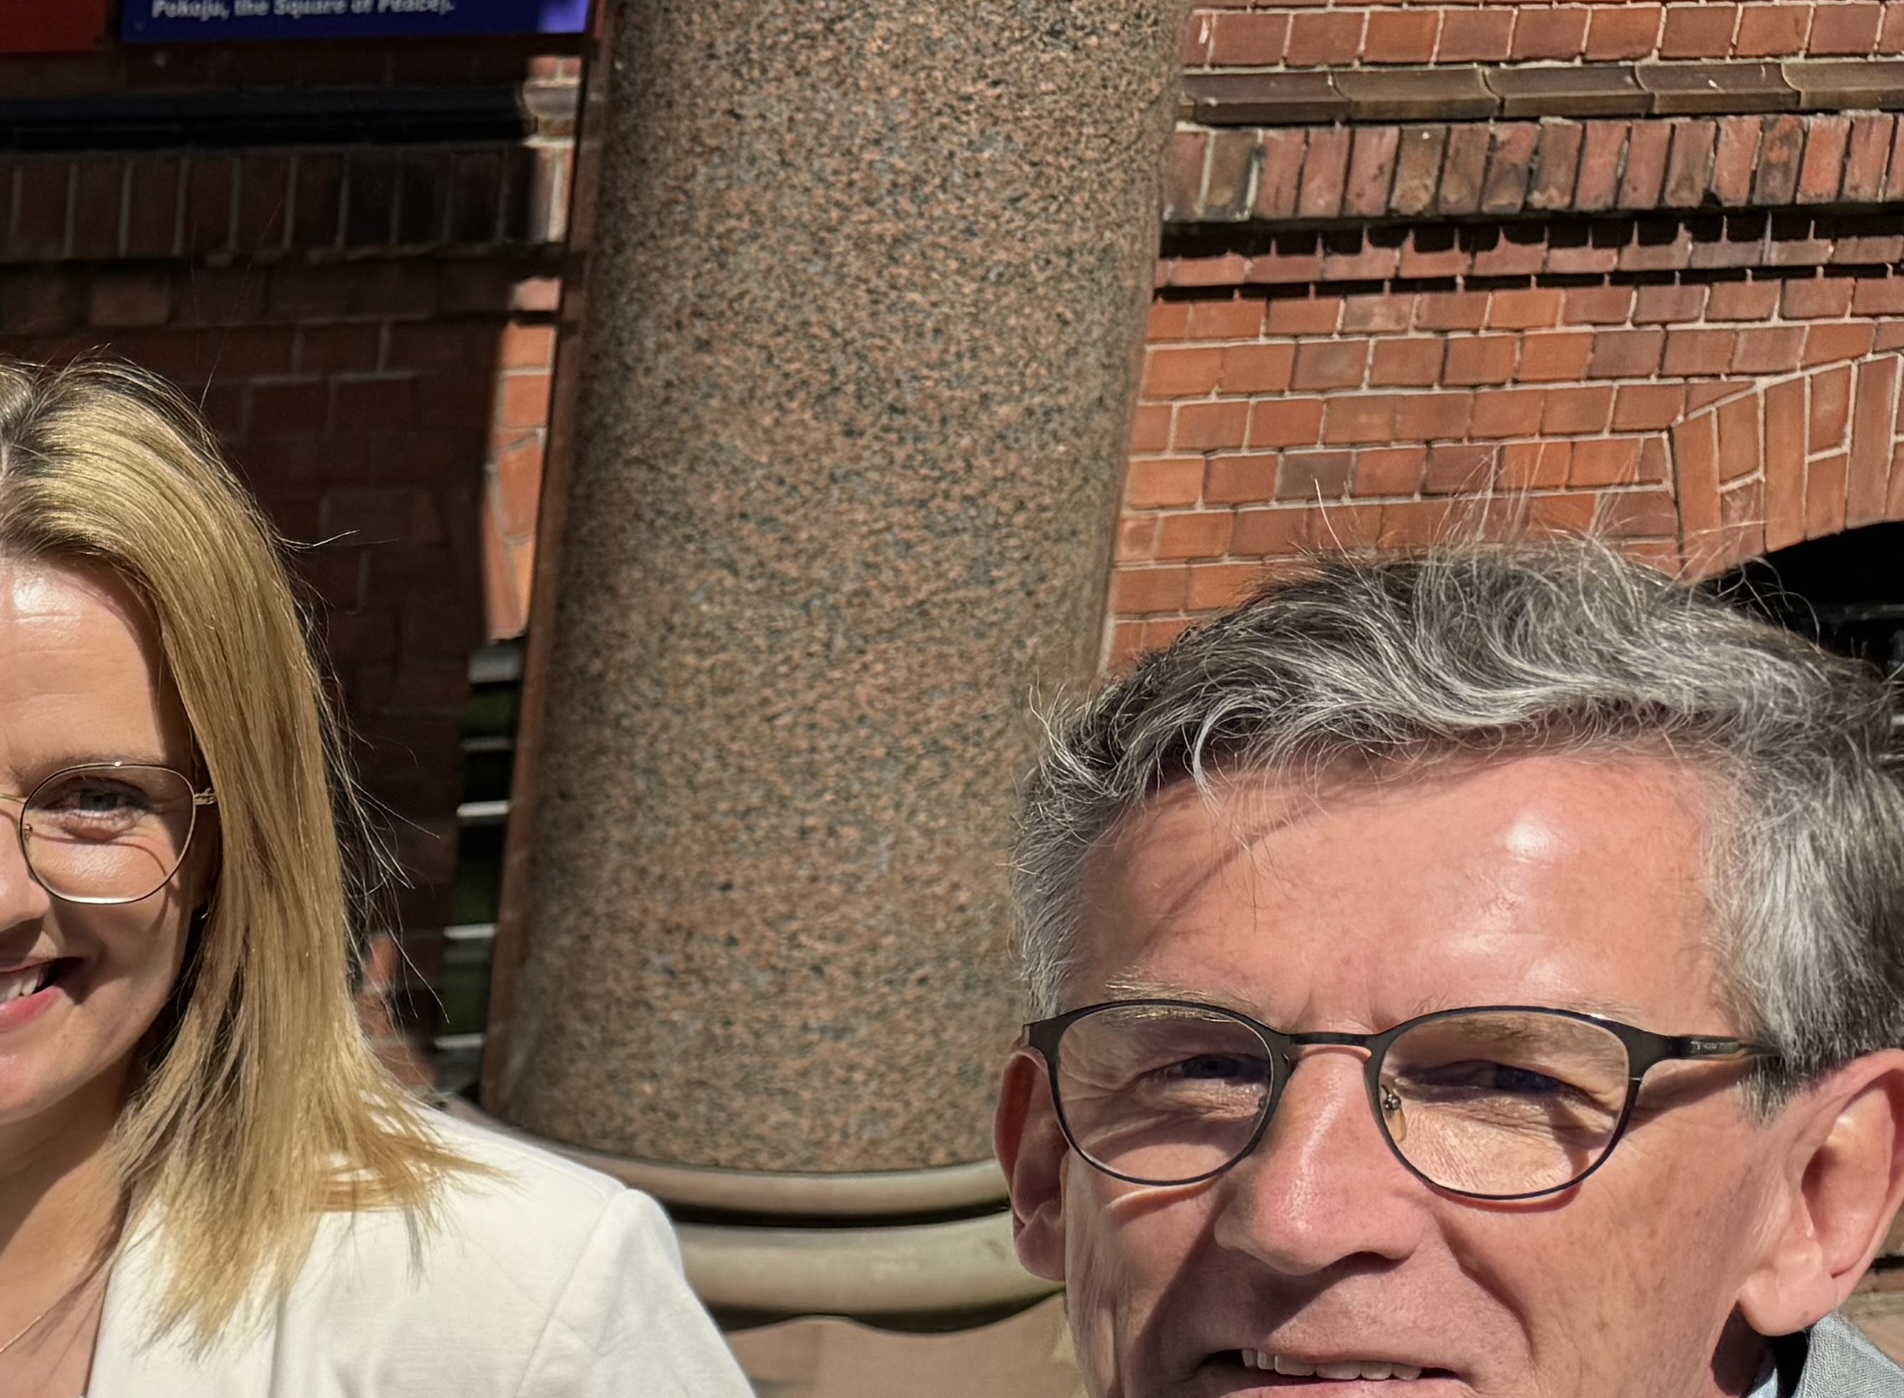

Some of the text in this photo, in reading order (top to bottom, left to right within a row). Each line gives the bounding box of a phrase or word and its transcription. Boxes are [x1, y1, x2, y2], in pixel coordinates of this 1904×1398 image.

[152, 0, 230, 21] Pokoju,
[234, 0, 270, 16] the
[273, 0, 347, 19] Square
